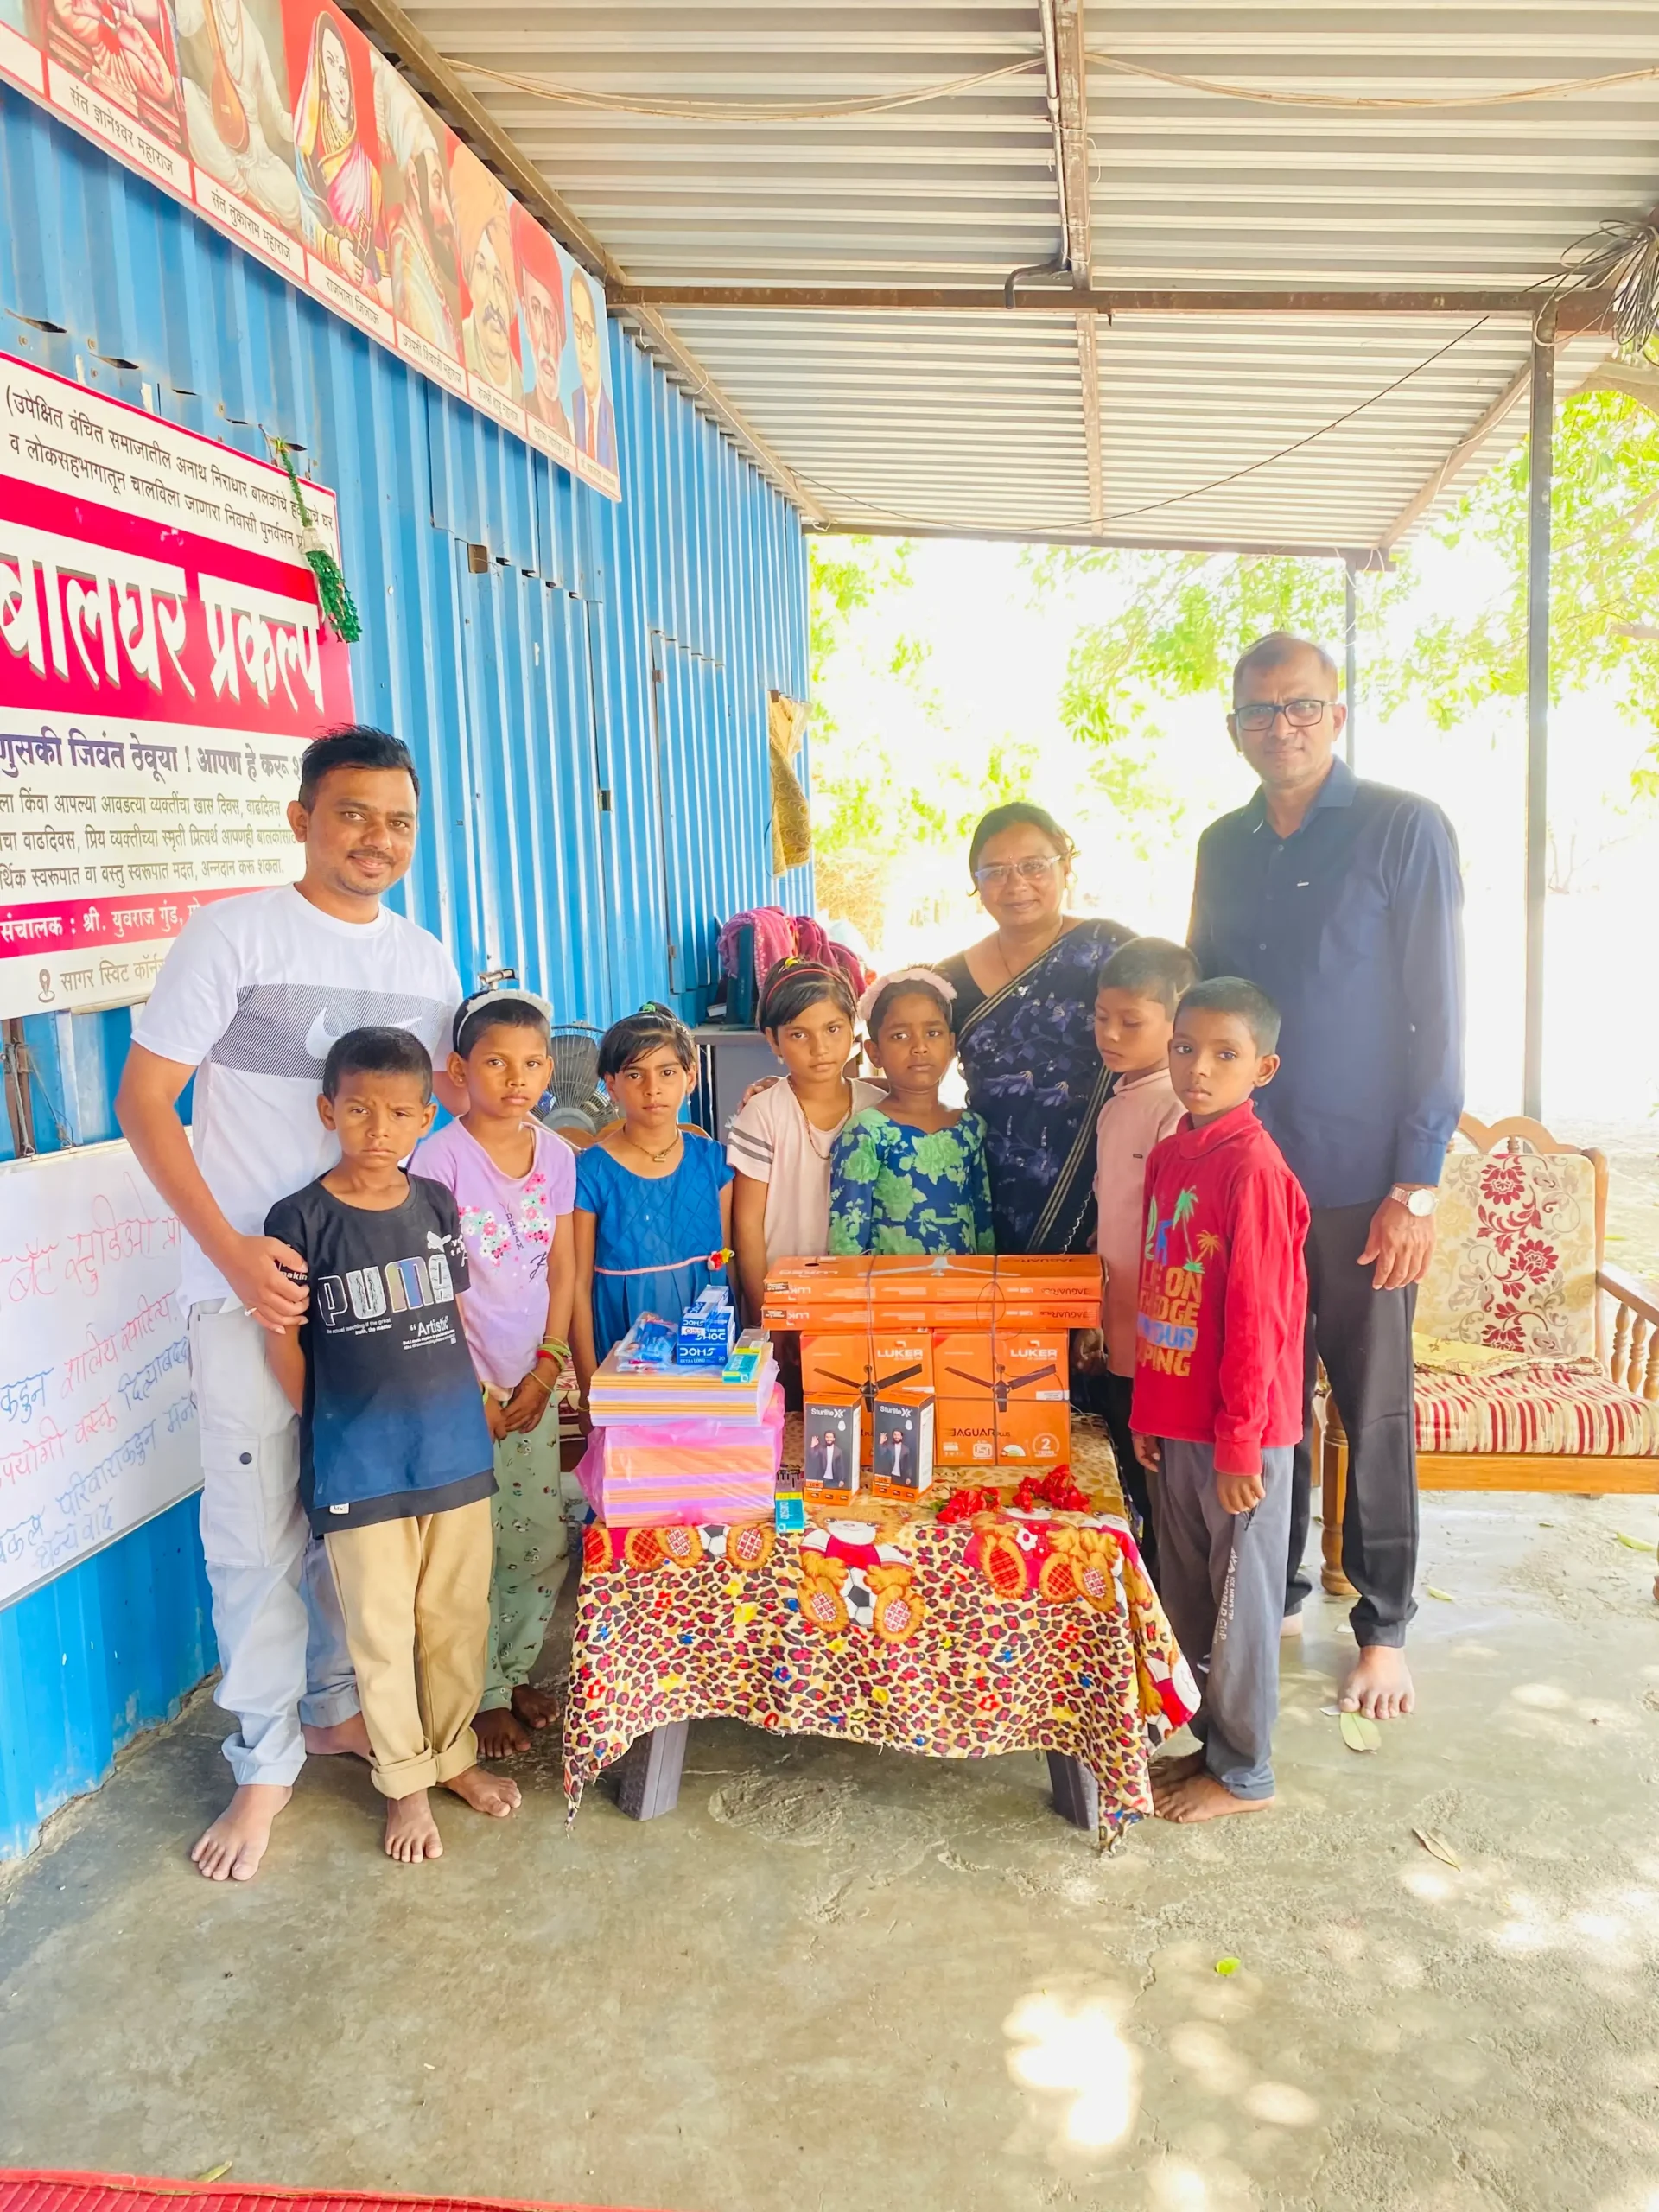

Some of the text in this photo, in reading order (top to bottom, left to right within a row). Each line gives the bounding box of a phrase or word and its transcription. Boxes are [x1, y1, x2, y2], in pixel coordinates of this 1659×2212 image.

[69, 85, 174, 176] संत ज्ञानेश्वर महाराज
[211, 189, 291, 262] संत तुकाराम महाराज
[325, 276, 353, 303] राजमाता
[7, 385, 63, 429] (उपेक्षित
[69, 410, 103, 444] वंचित
[108, 429, 171, 469] समाजातील
[176, 456, 207, 482] अनाथ
[211, 464, 247, 498] निराधार
[251, 485, 287, 512] बालकांचे
[321, 513, 334, 531] घर
[9, 433, 20, 454] व
[25, 435, 126, 495] लोकसहभागातून
[130, 475, 181, 509] चालविला
[184, 494, 221, 522] जाणारा
[225, 503, 257, 534] निवासी
[260, 521, 294, 548] पुनर्वसन
[198, 573, 323, 713] प्रकल्प
[68, 728, 125, 769] जिवंत
[130, 732, 178, 784] ठेवूया
[197, 747, 242, 776] आपण
[245, 742, 257, 782] हे
[259, 753, 289, 779] करू
[19, 787, 48, 814] किंवा
[54, 795, 97, 814] आपल्या
[101, 796, 146, 815] आवडत्या
[149, 791, 189, 815] व्यक्तींचा
[194, 798, 214, 815] खास
[217, 792, 244, 818] दिवस,
[245, 794, 281, 817] वाढदिवस
[22, 824, 80, 854] वाढदिवस,
[85, 824, 105, 849] प्रिय
[110, 823, 158, 848] व्यक्तीच्या
[162, 823, 185, 853] स्मृती
[221, 823, 253, 848] आपणही
[31, 867, 80, 887] स्वरूपात
[84, 866, 97, 884] वा
[100, 865, 126, 889] वस्तु
[128, 862, 169, 881] स्वरूपात
[172, 861, 198, 881] मदत,
[201, 860, 235, 878] अन्नदान
[0, 912, 63, 943] संचालक
[83, 906, 106, 932] श्री.
[111, 907, 155, 938] युवराज
[159, 899, 183, 932] गुंड,
[60, 969, 94, 992] सागर
[99, 959, 130, 986] स्विट
[505, 1212, 524, 1250] DREAM
[317, 1254, 454, 1326] PUMA
[1165, 1267, 1203, 1304] ON
[1154, 1294, 1201, 1327] DGE
[679, 1347, 716, 1357] DOMS
[877, 1349, 924, 1358] LUKER
[1010, 1349, 1058, 1358] LUKER
[950, 1428, 995, 1438] JAGUAR
[1041, 1438, 1051, 1450] 2
